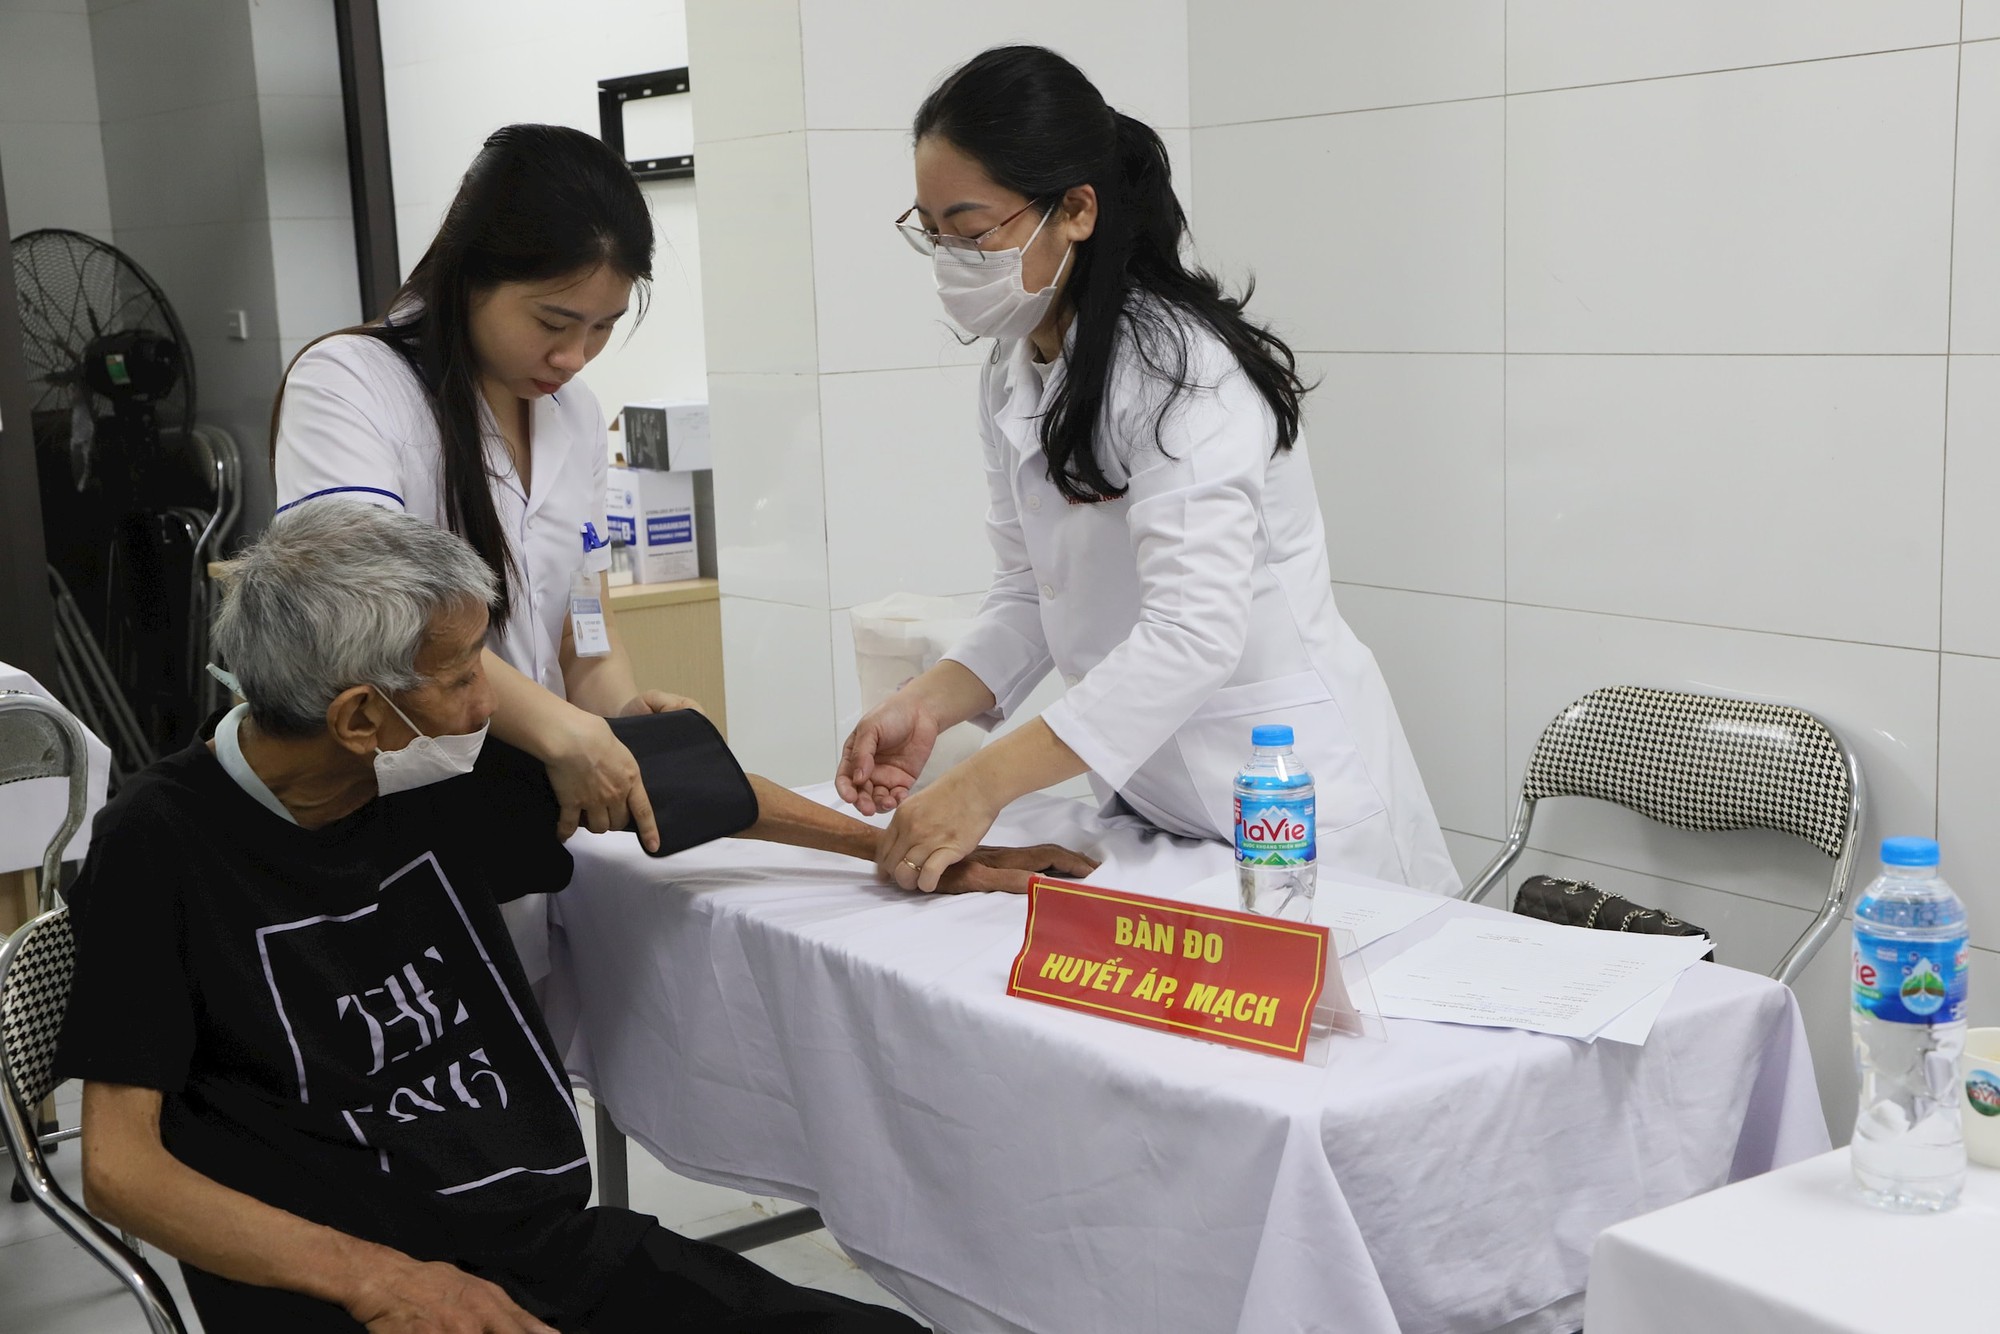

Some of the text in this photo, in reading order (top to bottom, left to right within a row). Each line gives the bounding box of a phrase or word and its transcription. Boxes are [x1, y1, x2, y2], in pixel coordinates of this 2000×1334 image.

[1243, 818, 1306, 842] laVie
[1115, 913, 1223, 964] BÀN ĐO
[1039, 952, 1281, 1027] HUYẾT ÁP, MẠCH
